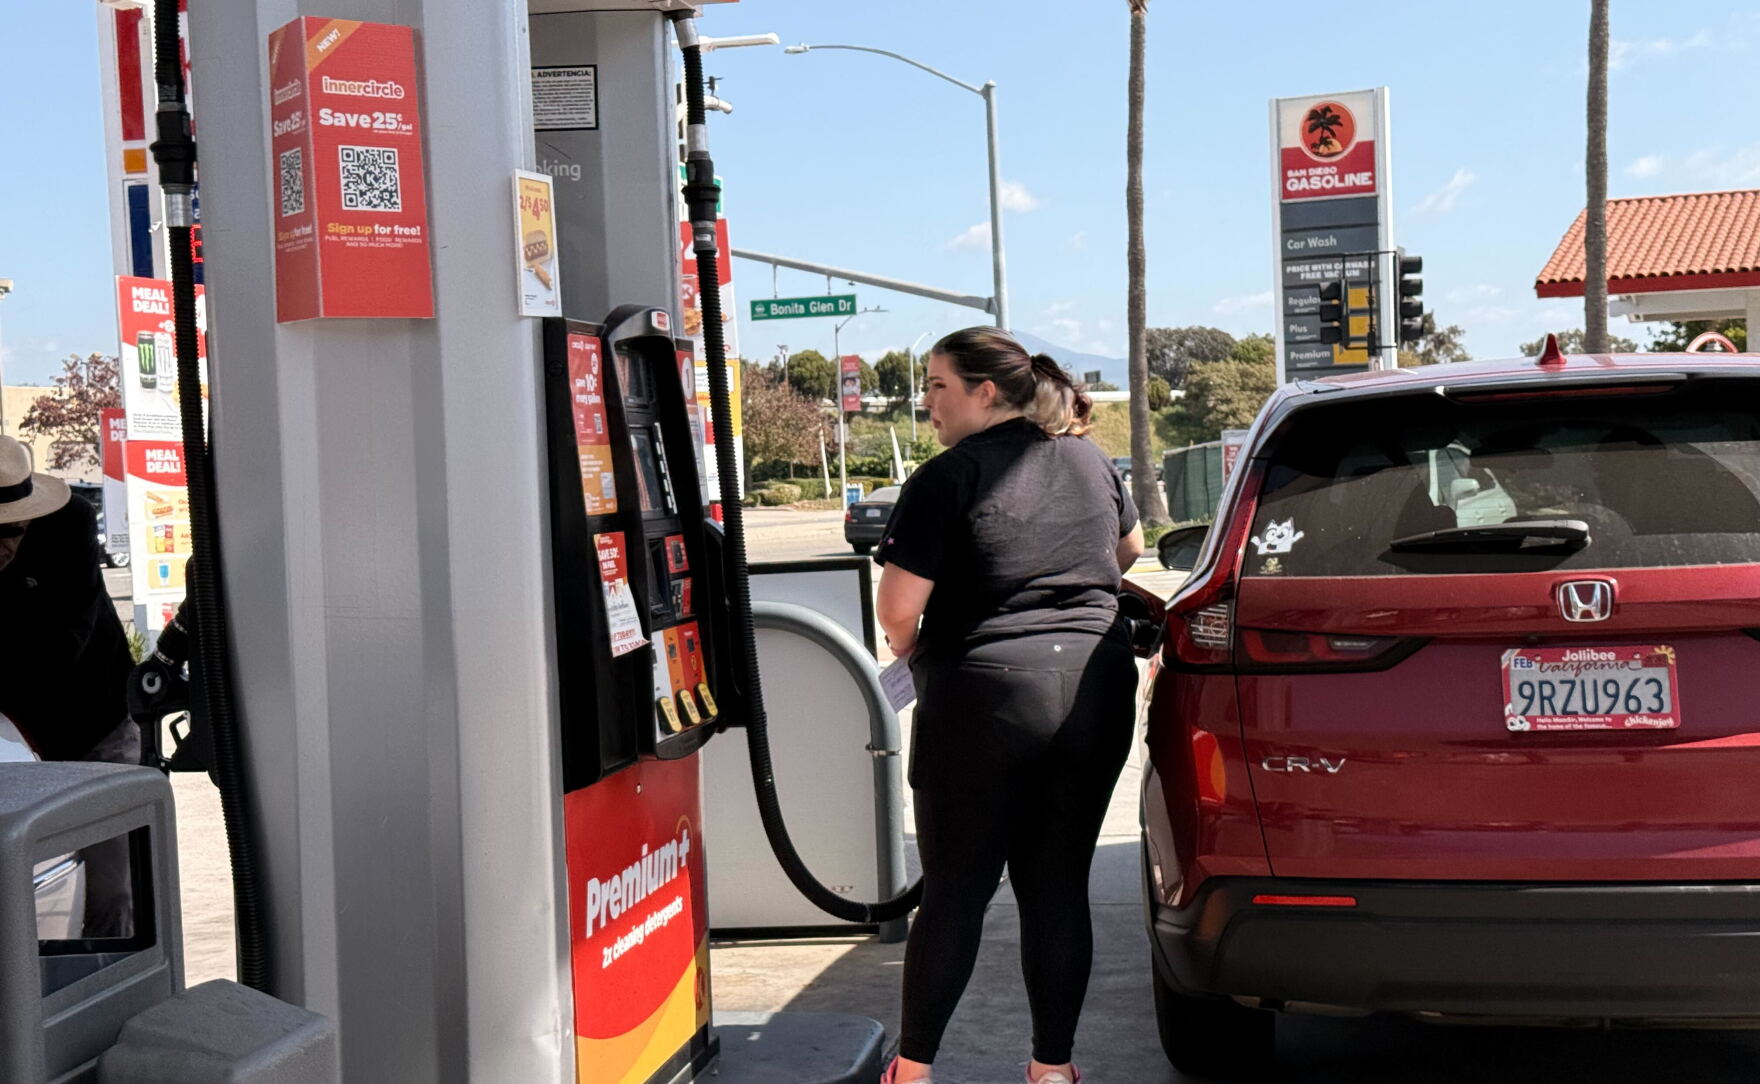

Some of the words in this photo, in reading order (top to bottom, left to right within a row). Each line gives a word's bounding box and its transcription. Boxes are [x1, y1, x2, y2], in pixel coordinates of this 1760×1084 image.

[322, 76, 404, 99] innercircle
[319, 108, 371, 129] Save
[1287, 169, 1307, 177] SAN
[1308, 166, 1337, 175] DIEGO
[1286, 172, 1373, 191] GASOLINE
[327, 223, 354, 235] Sign
[357, 225, 372, 235] up
[374, 224, 391, 234] for
[394, 225, 421, 235] free!
[1287, 239, 1304, 250] Car
[1307, 235, 1337, 248] Wash
[1286, 264, 1310, 273] PRICE
[1311, 262, 1333, 271] WITH
[1300, 271, 1321, 280] FREE
[132, 287, 168, 301] MEAL
[133, 300, 169, 314] DEAL!
[770, 303, 805, 315] Bonita
[809, 301, 834, 313] Glen
[838, 300, 851, 311] Dr
[1289, 324, 1308, 333] Plus
[1290, 350, 1331, 360] Premium
[145, 449, 179, 461] MEAL
[146, 461, 181, 473] DEAL!
[1562, 649, 1616, 661] Jollibee
[1513, 658, 1533, 668] FEB
[1518, 677, 1664, 716] 9RZU963
[1624, 715, 1675, 729] chickenjoy
[1262, 756, 1346, 773] CR-V
[586, 829, 690, 939] Premium+
[613, 925, 645, 960] cleaning
[645, 895, 683, 937] detergents
